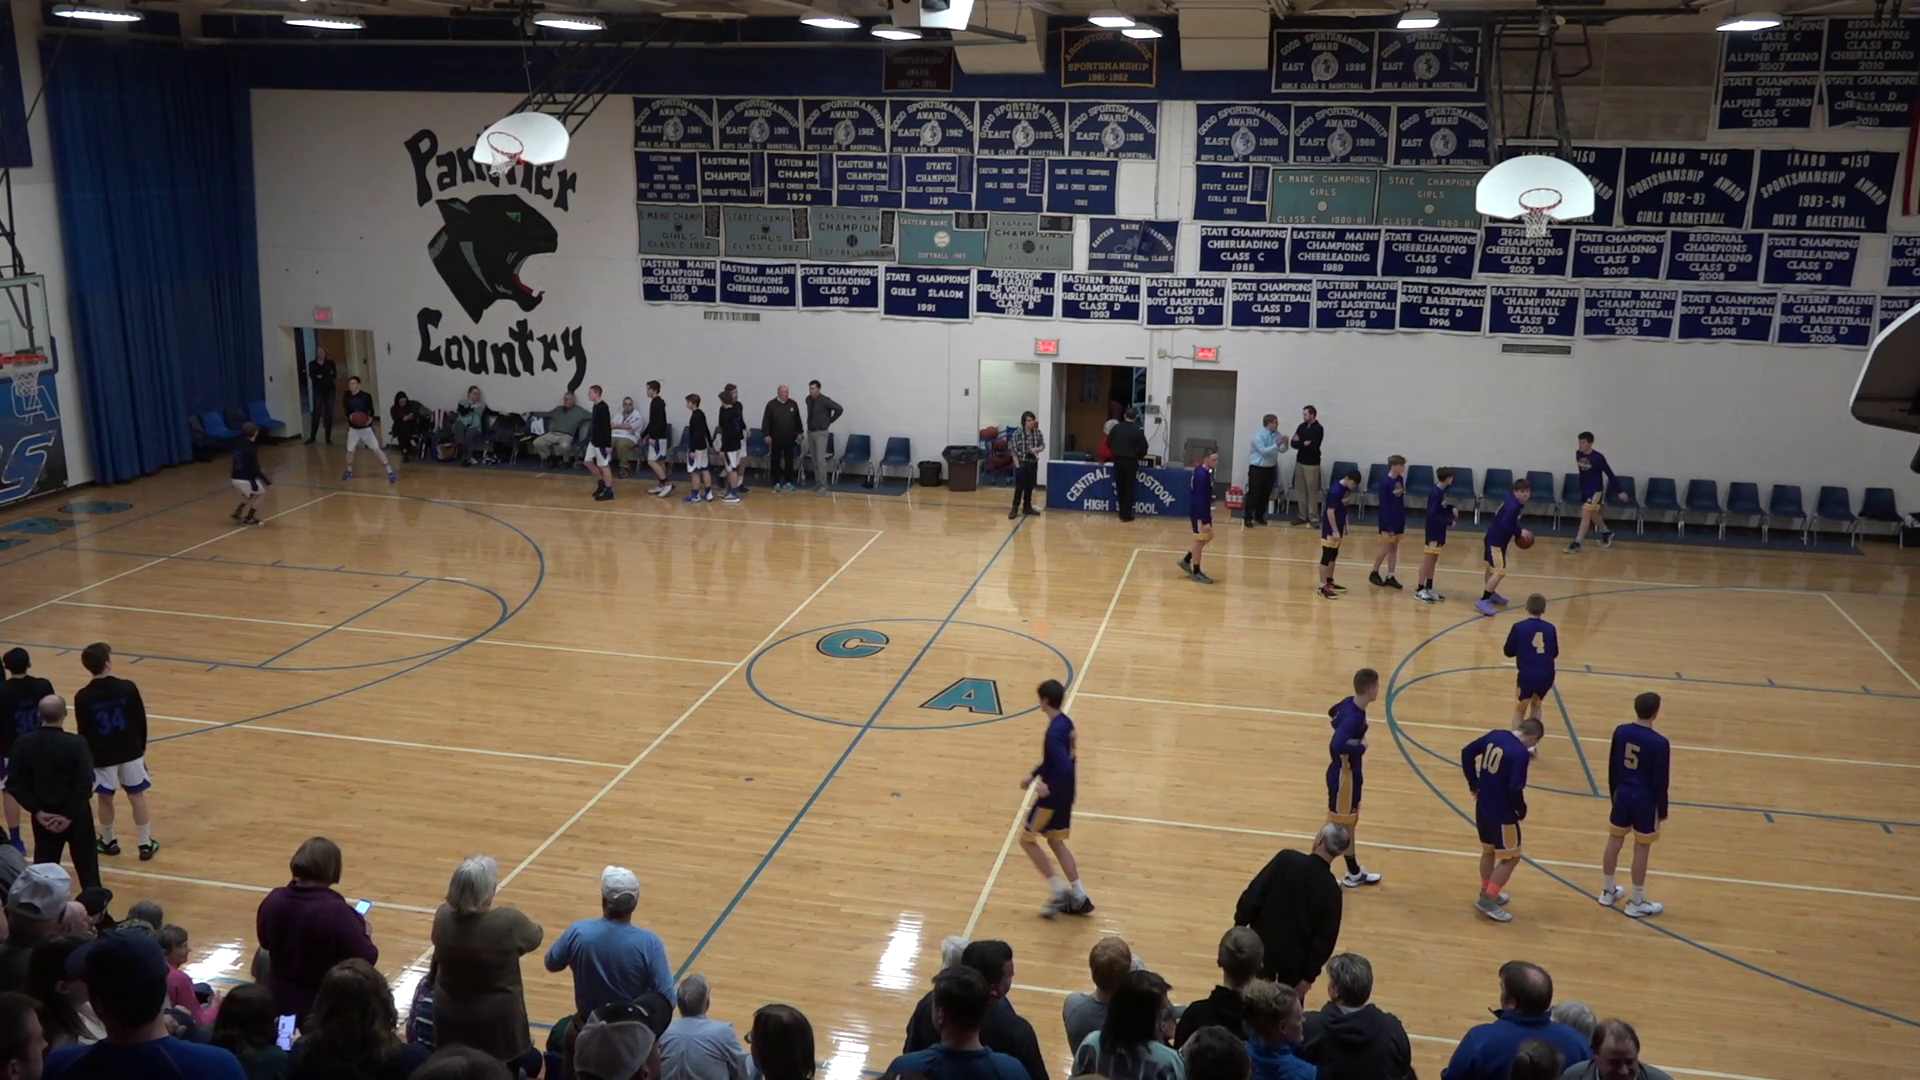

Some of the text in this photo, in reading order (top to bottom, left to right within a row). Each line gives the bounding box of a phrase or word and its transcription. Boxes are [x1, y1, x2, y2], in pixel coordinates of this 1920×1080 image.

[1728, 53, 1819, 63] ALPINE SKIING
[1755, 88, 1782, 96] BOYS
[1722, 98, 1813, 109] ALPINE SKIING
[907, 101, 974, 133] SPORTSMANSHIP
[916, 112, 947, 120] AWARD
[1088, 104, 1156, 135] SPORTSMANSHIP
[1097, 114, 1128, 123] AWARD
[1197, 106, 1289, 136] GOOD SPORTSMANSHIP
[1227, 119, 1260, 127] AWARD
[897, 129, 920, 137] EAST
[1205, 137, 1229, 146] EAST
[1650, 152, 1685, 164] IAABO
[1787, 153, 1826, 166] IAABO
[404, 129, 577, 212] Panher
[1288, 175, 1371, 184] MAINE CHAMPIONS
[1389, 176, 1477, 187] STATE CHAMPIONS
[1626, 170, 1746, 202] SPORTSMANSHIP AWARD
[1759, 171, 1886, 206] SPORTSMANSHIP AWARD
[1310, 188, 1336, 197] GIRLS
[1417, 190, 1444, 199] GIRLS
[1662, 192, 1706, 205] 1992-93
[1798, 194, 1847, 208] 1993-94
[1636, 212, 1725, 225] GIRLS BASKETBALL
[1772, 214, 1866, 229] BOYS BASKETBALL
[1201, 227, 1286, 238] STATE CHAMPIONS
[1293, 231, 1379, 241] EASTERN MAINE
[1386, 232, 1477, 244] STATE CHAMPIONS
[1498, 237, 1554, 248] CHAMPION
[1575, 233, 1665, 243] STATE CHAMPIONS
[1688, 234, 1744, 243] REGIONAL
[1767, 237, 1859, 248] STATE CHAMPIONS
[1207, 239, 1279, 249] CHEERLEADING
[1306, 241, 1364, 252] CHAMPIONS
[1392, 242, 1467, 255] CHEERLEADING
[1683, 243, 1747, 253] CHAMPIONS
[1485, 245, 1564, 257] CHEERLEADING
[1579, 245, 1657, 255] CHEERLEADING
[1773, 249, 1850, 260] CHEERLEADING
[1220, 252, 1250, 261] CLASS
[1297, 252, 1370, 262] CHEERLEADING
[1404, 254, 1433, 264] CLASS
[1501, 255, 1533, 265] CLASS
[1594, 255, 1627, 264] CLASS
[1675, 252, 1752, 263] CHEERLEADING
[642, 260, 716, 270] EASTERN MAINE
[721, 264, 795, 275] EASTERN MAINE
[1231, 263, 1255, 272] 1988
[1322, 263, 1344, 272] 1989
[1415, 265, 1438, 274] 1989
[1508, 265, 1535, 274] 2002
[1688, 263, 1723, 272] CLASS
[1787, 261, 1820, 270] CLASS
[653, 268, 704, 277] CHAMPIONS
[800, 267, 878, 277] STATE CHAMPIONS
[990, 271, 1042, 280] AROOSTOOK
[1603, 266, 1629, 276] 2002
[666, 277, 716, 286] BASKETBALL
[733, 275, 783, 284] CHAMPIONS
[807, 277, 871, 286] CHEERLEADING
[885, 273, 970, 284] STATE CHAMPIONS
[1063, 274, 1140, 285] EASTERN MAINE
[1146, 278, 1226, 288] EASTERN MAINE
[660, 285, 686, 293] CLASS
[727, 283, 790, 295] CHEERLEADING
[819, 286, 847, 295] CLASS
[1002, 286, 1054, 296] VOLLEYBALL
[1073, 284, 1128, 294] CHAMPIONS
[1231, 281, 1312, 292] STATE CHAMPIONS
[1316, 281, 1398, 291] EASTERN MAINE
[1401, 285, 1487, 297] STATE CHAMPIONS
[670, 292, 689, 301] 1990
[890, 287, 964, 299] GIRLS SLALOM
[1157, 287, 1215, 297] CHAMPIONS
[1327, 291, 1387, 300] CHAMPIONS
[1491, 288, 1580, 298] EASTERN MAINE
[1584, 290, 1677, 300] EASTERN MAINE
[749, 295, 768, 303] 1990
[829, 296, 849, 305] 1990
[1061, 292, 1140, 303] GIRLS BASKETBALL
[1146, 297, 1224, 306] BOYS BASKETBALL
[1232, 293, 1311, 303] BOYS BASKETBALL
[1425, 296, 1485, 307] BASKETBALL
[1503, 297, 1566, 307] CHAMPIONS
[1681, 294, 1776, 305] STATE CHAMPIONS
[1781, 294, 1876, 305] EASTERN MAINE
[917, 303, 936, 312] 1991
[1079, 301, 1108, 311] CLASS
[1252, 304, 1281, 313] CLASS
[1341, 300, 1397, 310] BASKETBALL
[1597, 299, 1662, 309] CHAMPIONS
[1089, 310, 1110, 319] 1993
[1165, 306, 1194, 315] CLASS
[1335, 309, 1365, 318] CLASS
[1419, 307, 1450, 316] CLASS
[1507, 306, 1560, 316] BASEBALL
[1615, 309, 1674, 319] BASKETBALL
[1710, 305, 1774, 316] BASKETBALL
[1793, 305, 1861, 315] CHAMPIONS
[1174, 315, 1195, 324] 1994
[1260, 315, 1280, 323] 1994
[1345, 319, 1366, 328] 1996
[1428, 318, 1450, 327] 1996
[1510, 315, 1542, 325] CLASS
[1604, 317, 1637, 327] CLASS
[1701, 316, 1735, 326] CLASS
[1519, 325, 1544, 334] 2003
[417, 307, 587, 391] Country
[1066, 467, 1111, 502] CENTRAL
[1083, 499, 1109, 511] HIGH
[816, 629, 890, 658] C
[1531, 631, 1545, 654] 4
[917, 677, 1003, 715] A
[94, 707, 126, 735] 34
[1482, 743, 1503, 775] 10
[1623, 742, 1641, 770] 5
